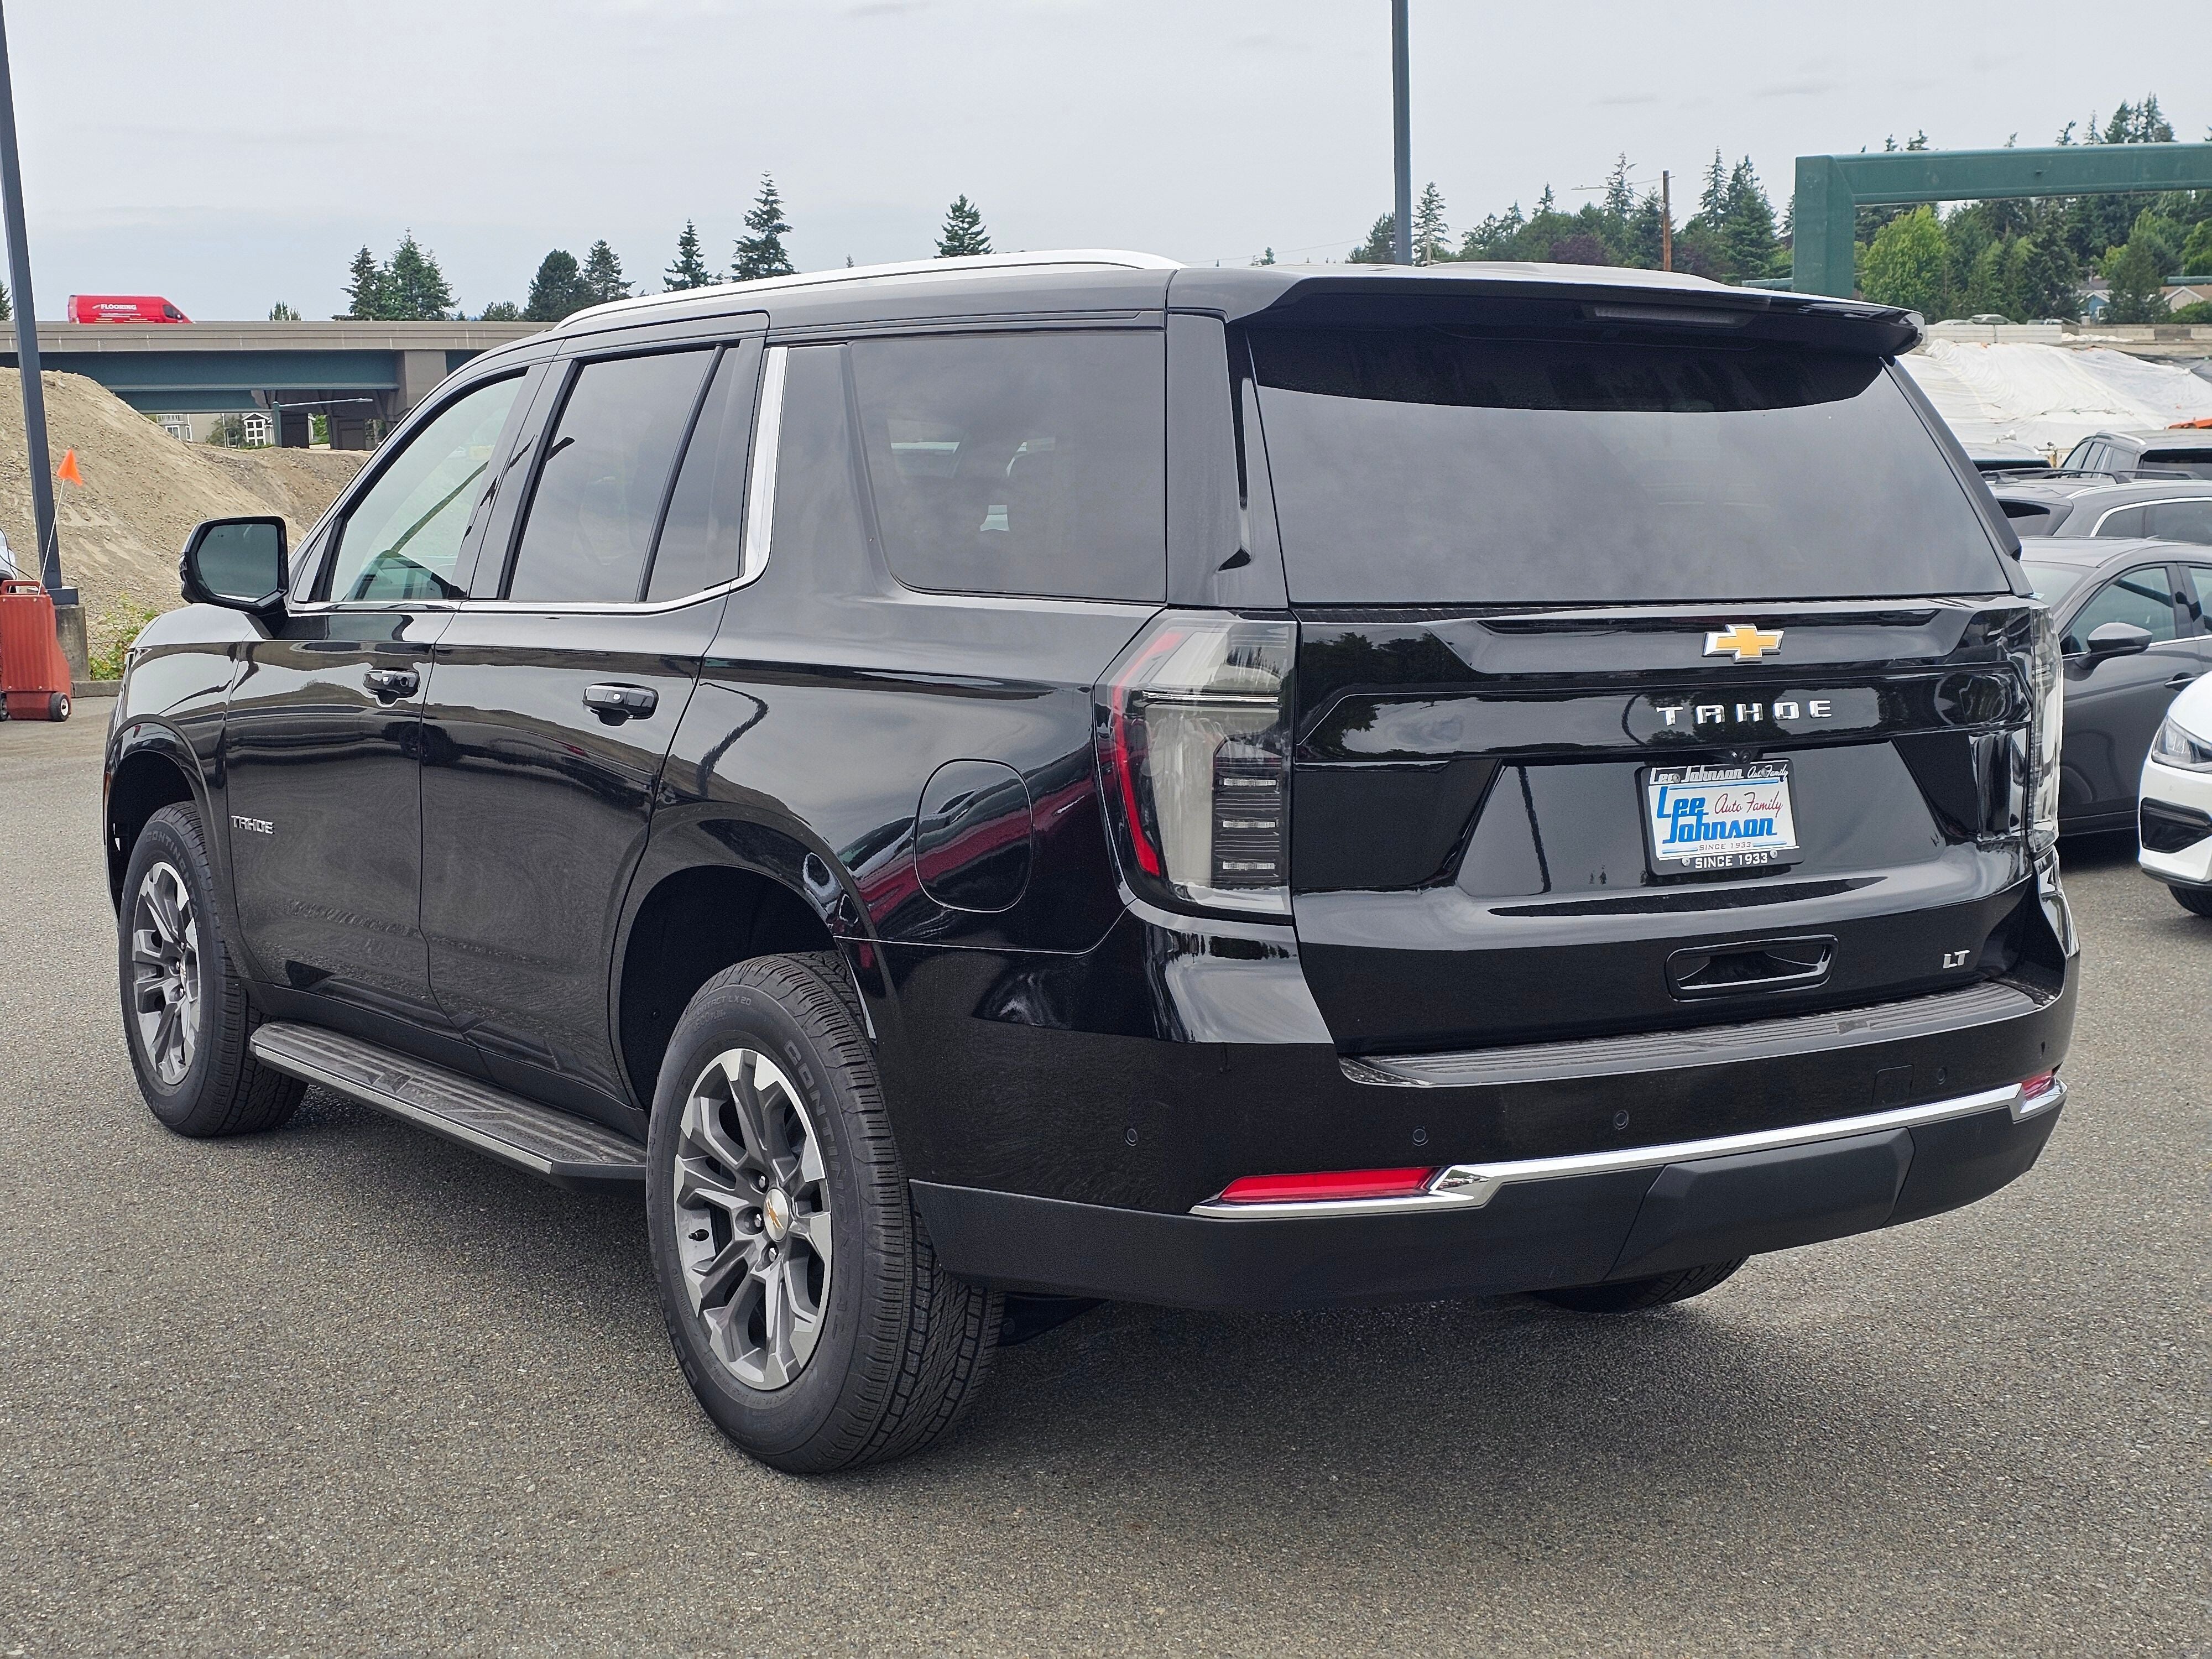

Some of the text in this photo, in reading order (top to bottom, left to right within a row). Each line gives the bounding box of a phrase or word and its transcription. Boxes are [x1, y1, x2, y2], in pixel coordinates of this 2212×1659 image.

[1656, 700, 1833, 726] TAHOE
[1650, 764, 1789, 784] Lee Johnson Aut Family
[1657, 786, 1709, 818] Lee
[1714, 790, 1783, 818] Auto Family
[231, 815, 275, 834] TAHOE
[1662, 809, 1777, 844] Johnson
[1695, 852, 1768, 869] SINCE 1933
[1943, 950, 1970, 969] LT
